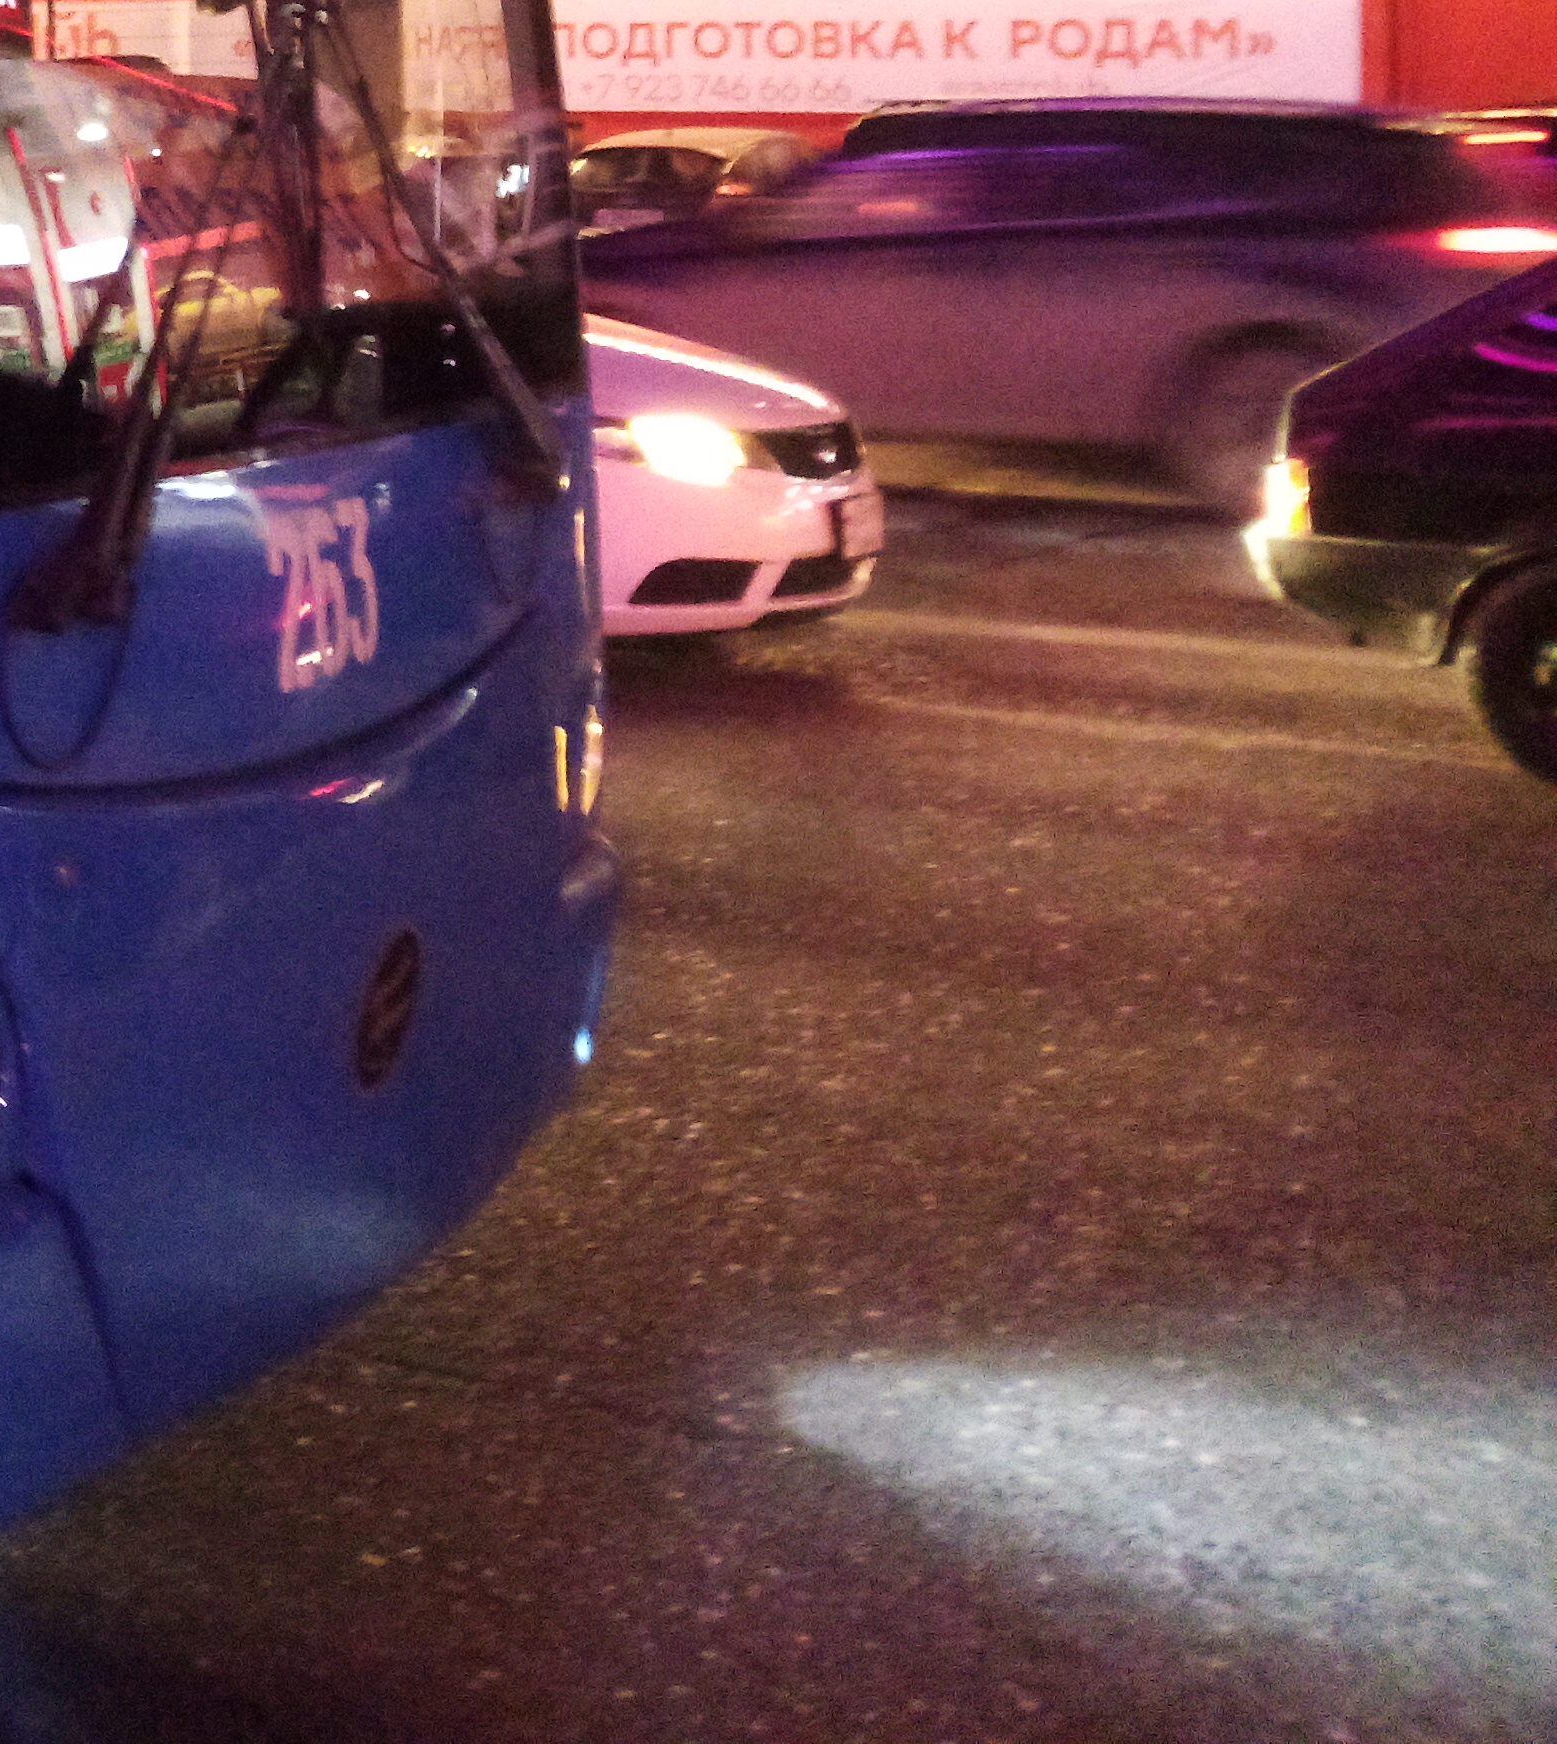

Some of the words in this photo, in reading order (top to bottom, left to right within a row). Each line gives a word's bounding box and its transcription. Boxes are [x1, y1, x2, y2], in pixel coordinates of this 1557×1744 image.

[944, 20, 980, 58] К
[1009, 17, 1279, 69] РОДАМ»
[256, 497, 380, 693] 263
